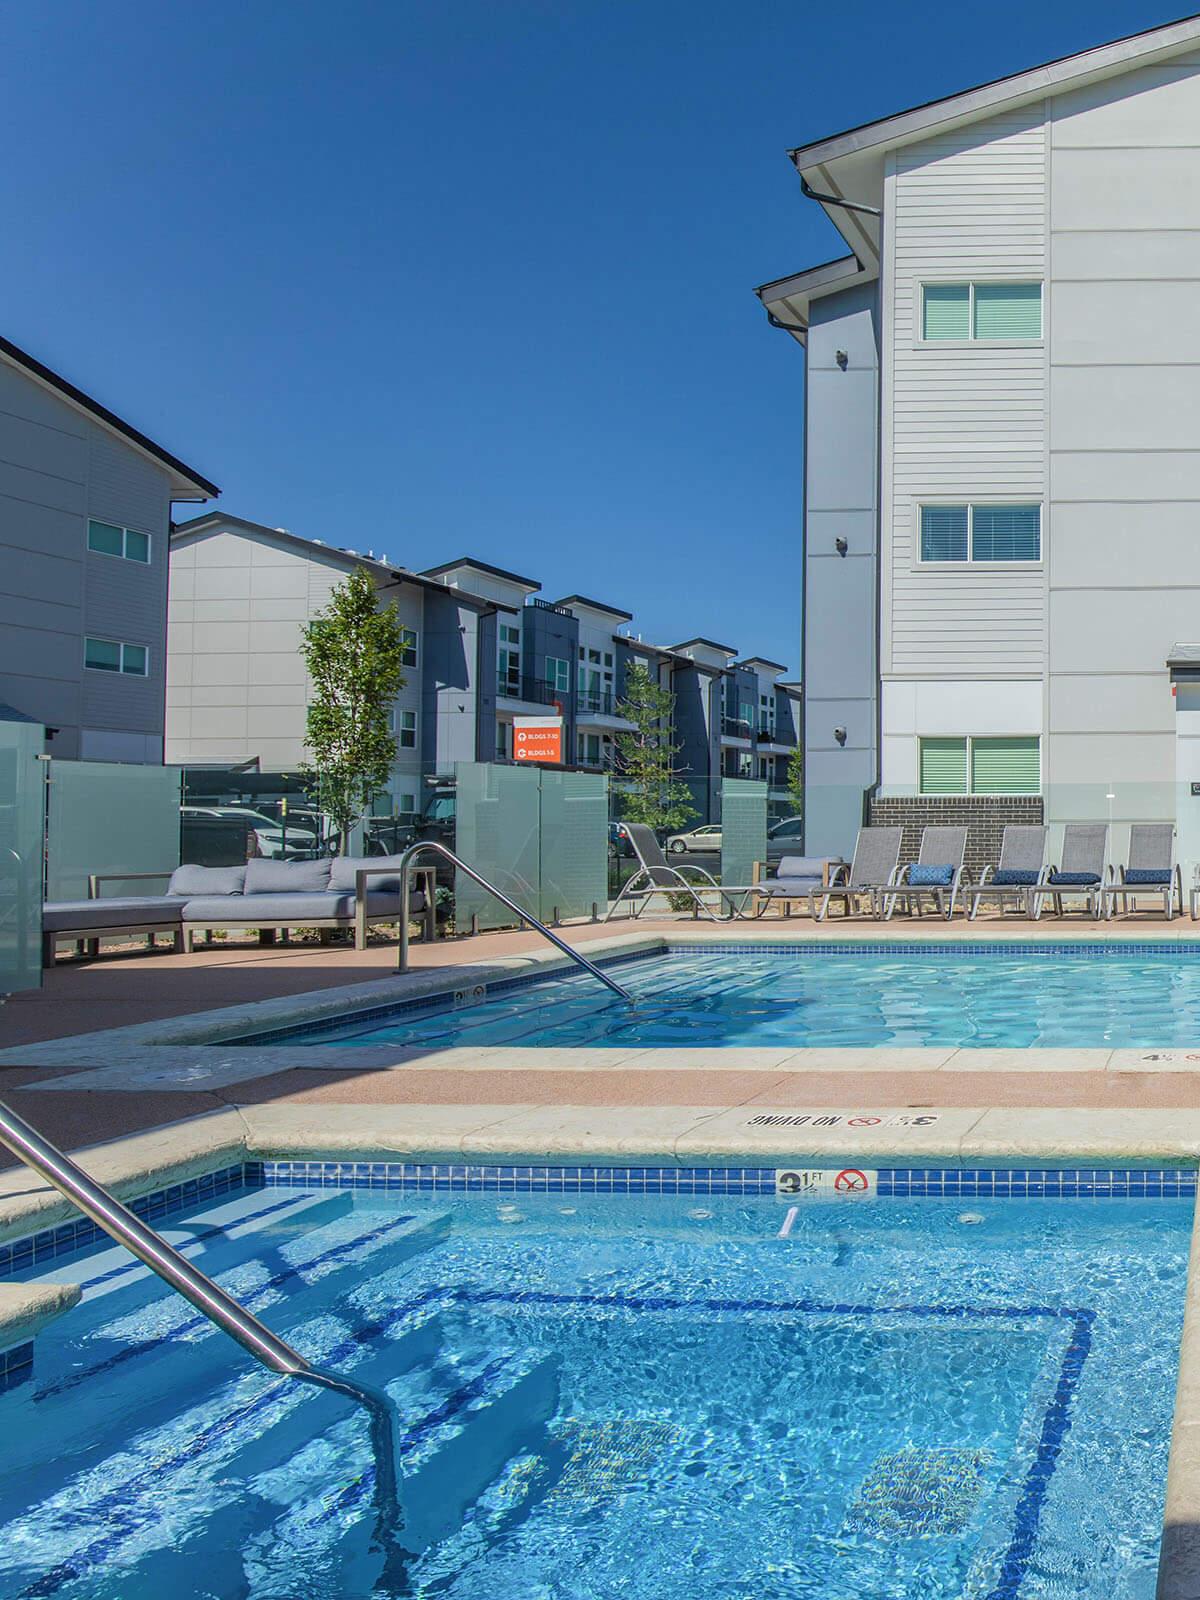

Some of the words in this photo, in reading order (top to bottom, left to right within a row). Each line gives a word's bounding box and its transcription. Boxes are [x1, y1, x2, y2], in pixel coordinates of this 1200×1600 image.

[747, 1115, 812, 1126] DIVING
[811, 1116, 843, 1126] NO
[812, 1172, 823, 1182] FT
